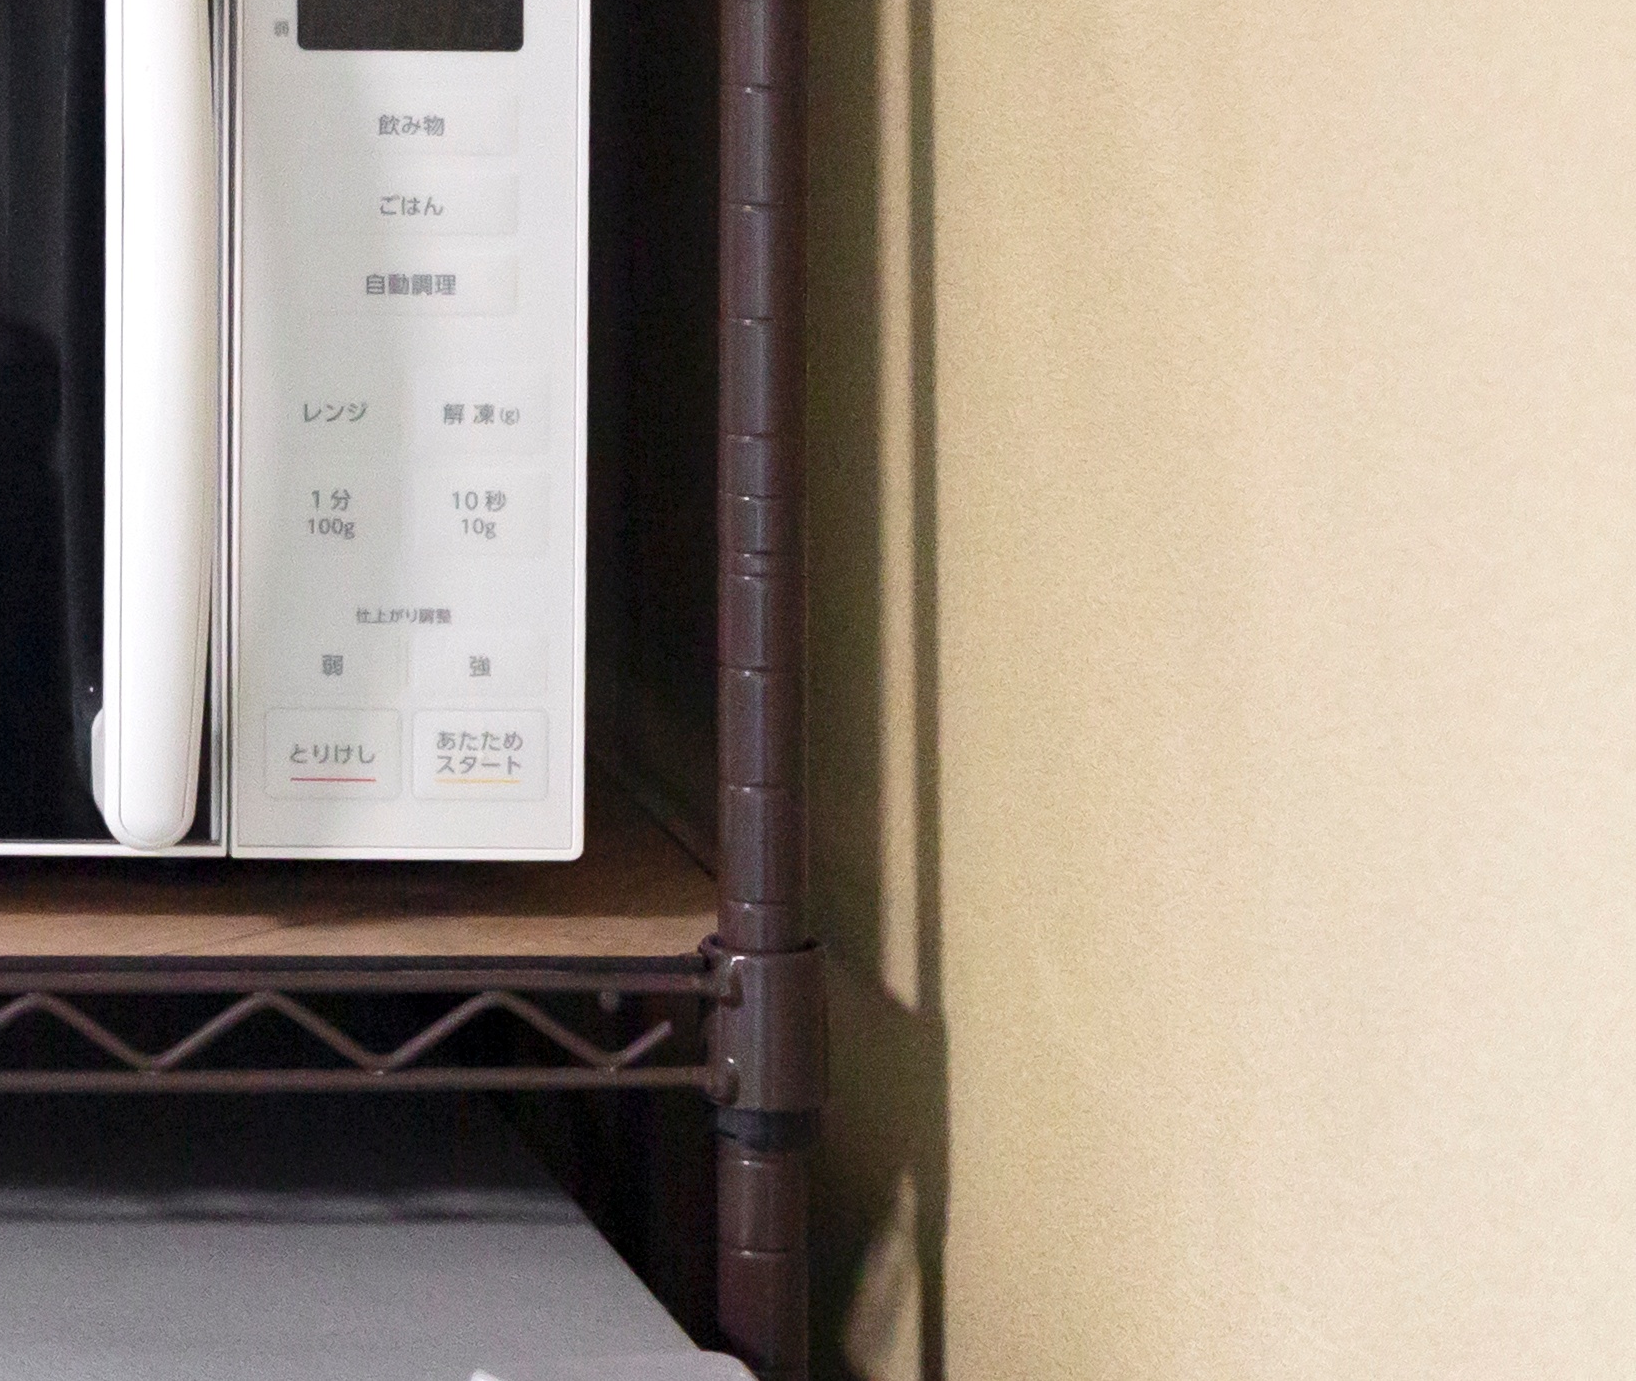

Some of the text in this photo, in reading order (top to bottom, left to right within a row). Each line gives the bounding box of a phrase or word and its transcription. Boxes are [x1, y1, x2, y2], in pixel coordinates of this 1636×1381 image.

[378, 114, 445, 137] 飲み物
[380, 195, 444, 217] ごはん
[365, 273, 456, 296] 自動調理
[302, 402, 368, 423] レンジ
[308, 517, 356, 540] 100g
[462, 518, 497, 540] 10g
[436, 731, 524, 752] あたため
[289, 744, 376, 765] とりけし
[437, 755, 522, 775] スタート
